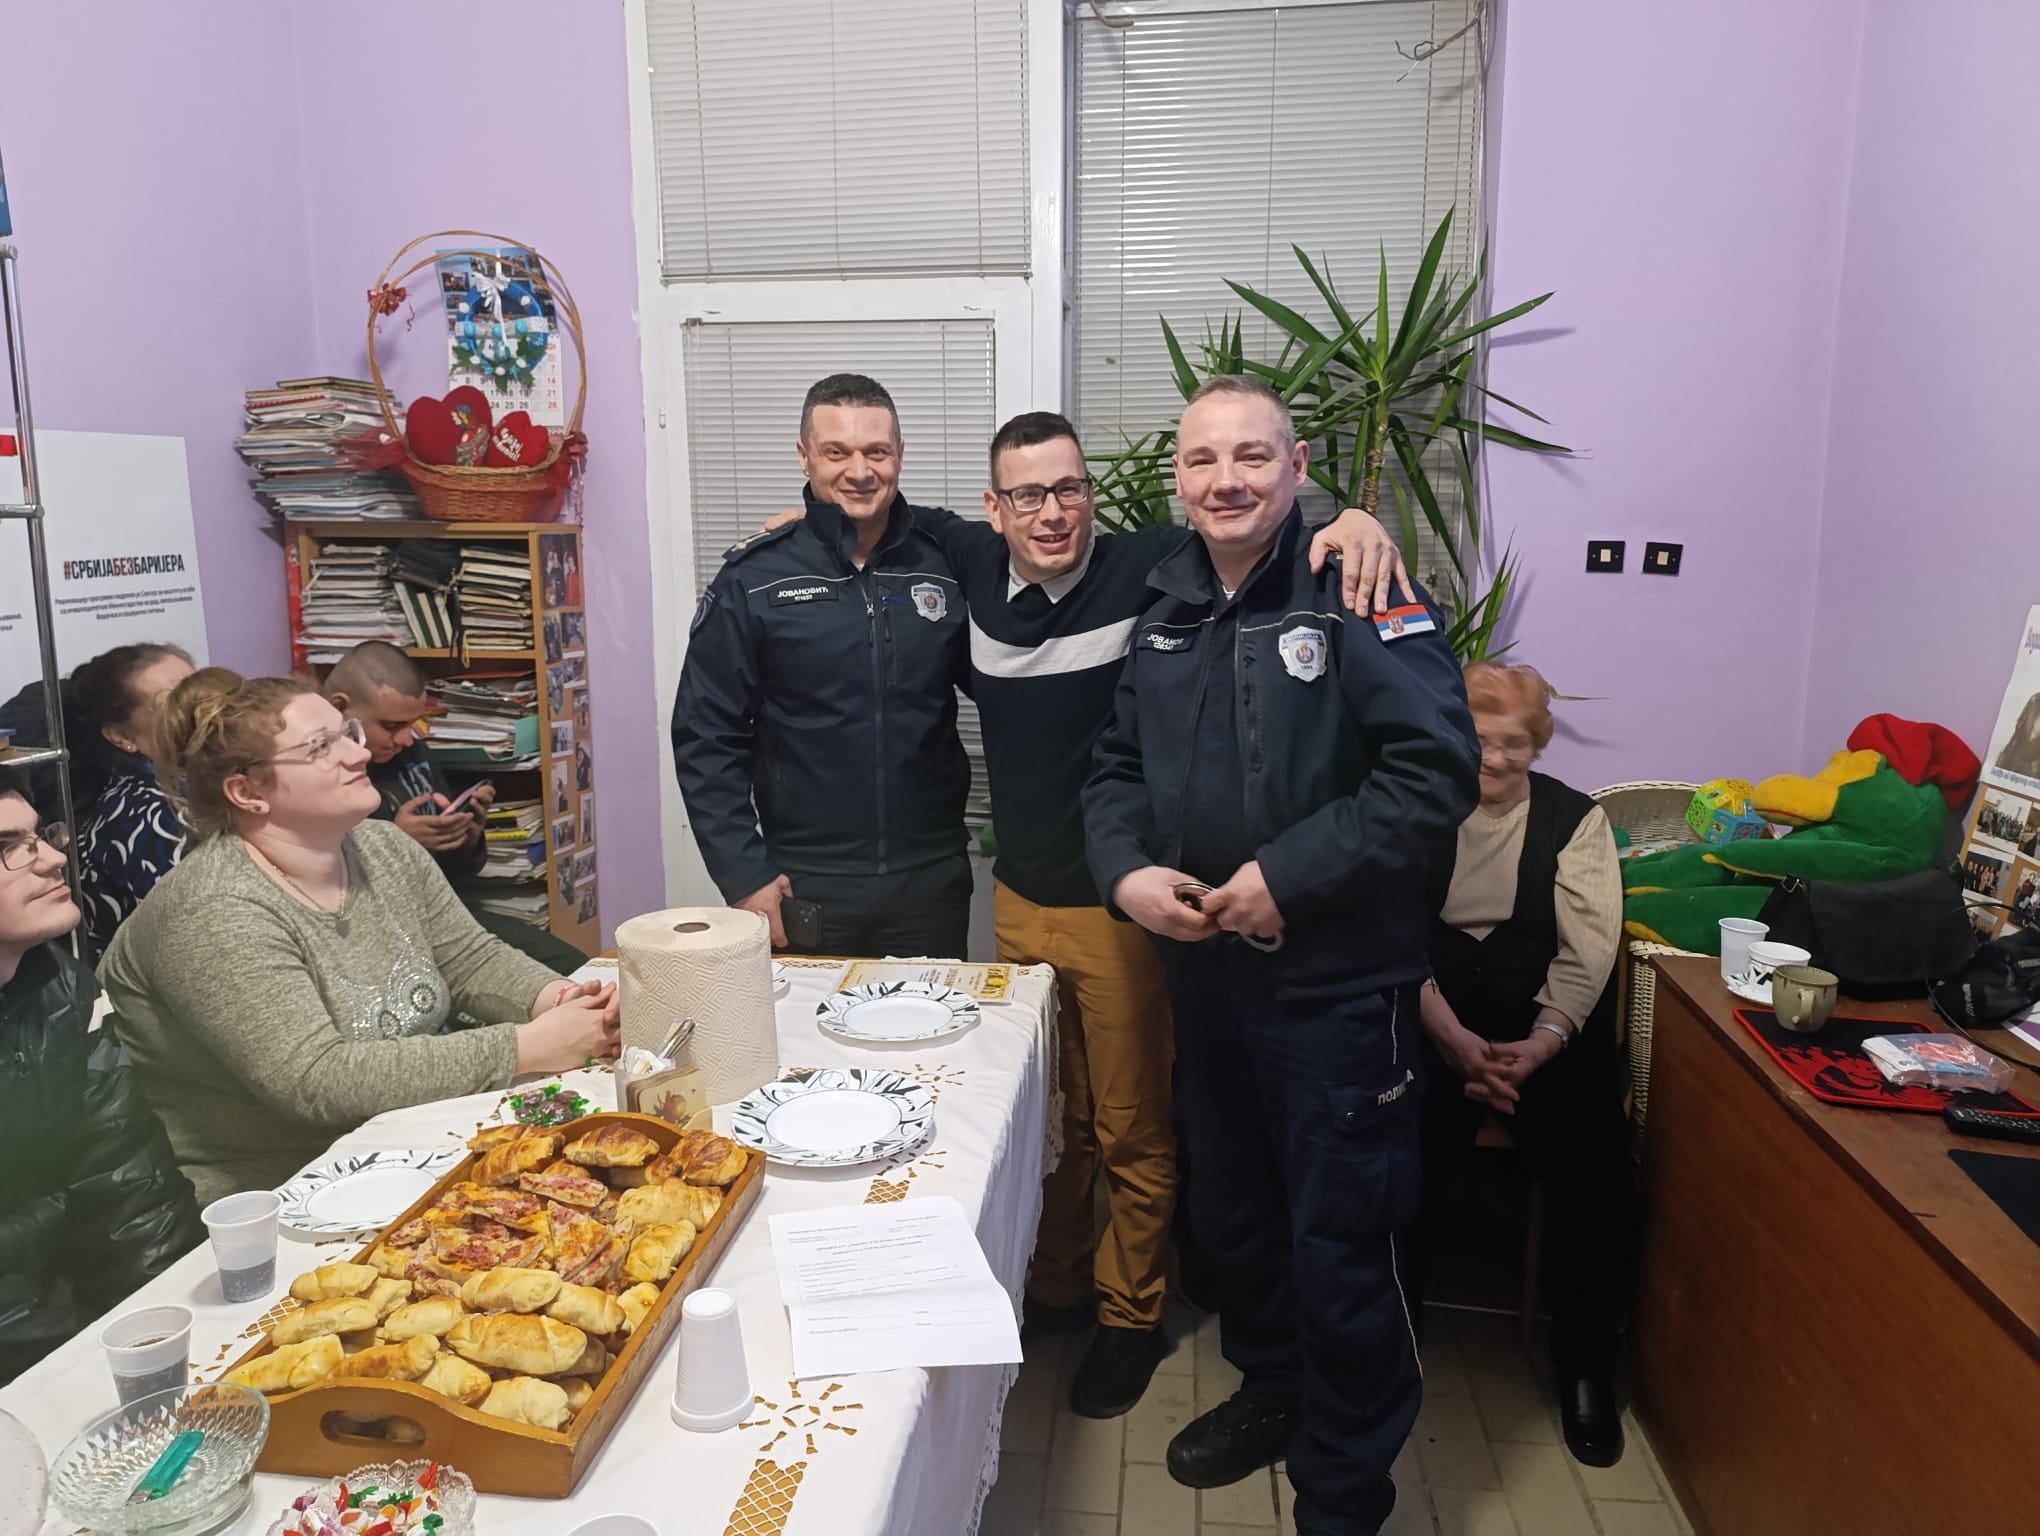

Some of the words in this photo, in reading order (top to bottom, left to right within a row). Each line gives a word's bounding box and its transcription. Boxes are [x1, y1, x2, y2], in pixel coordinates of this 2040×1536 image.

[547, 377, 556, 385] 14
[547, 389, 556, 397] 21
[504, 401, 515, 409] 25
[519, 401, 530, 409] 26
[64, 554, 185, 580] #СРБИЈАБЕЗБАРИЈЕРА
[777, 586, 829, 597] ЈОВАНОВИЋ
